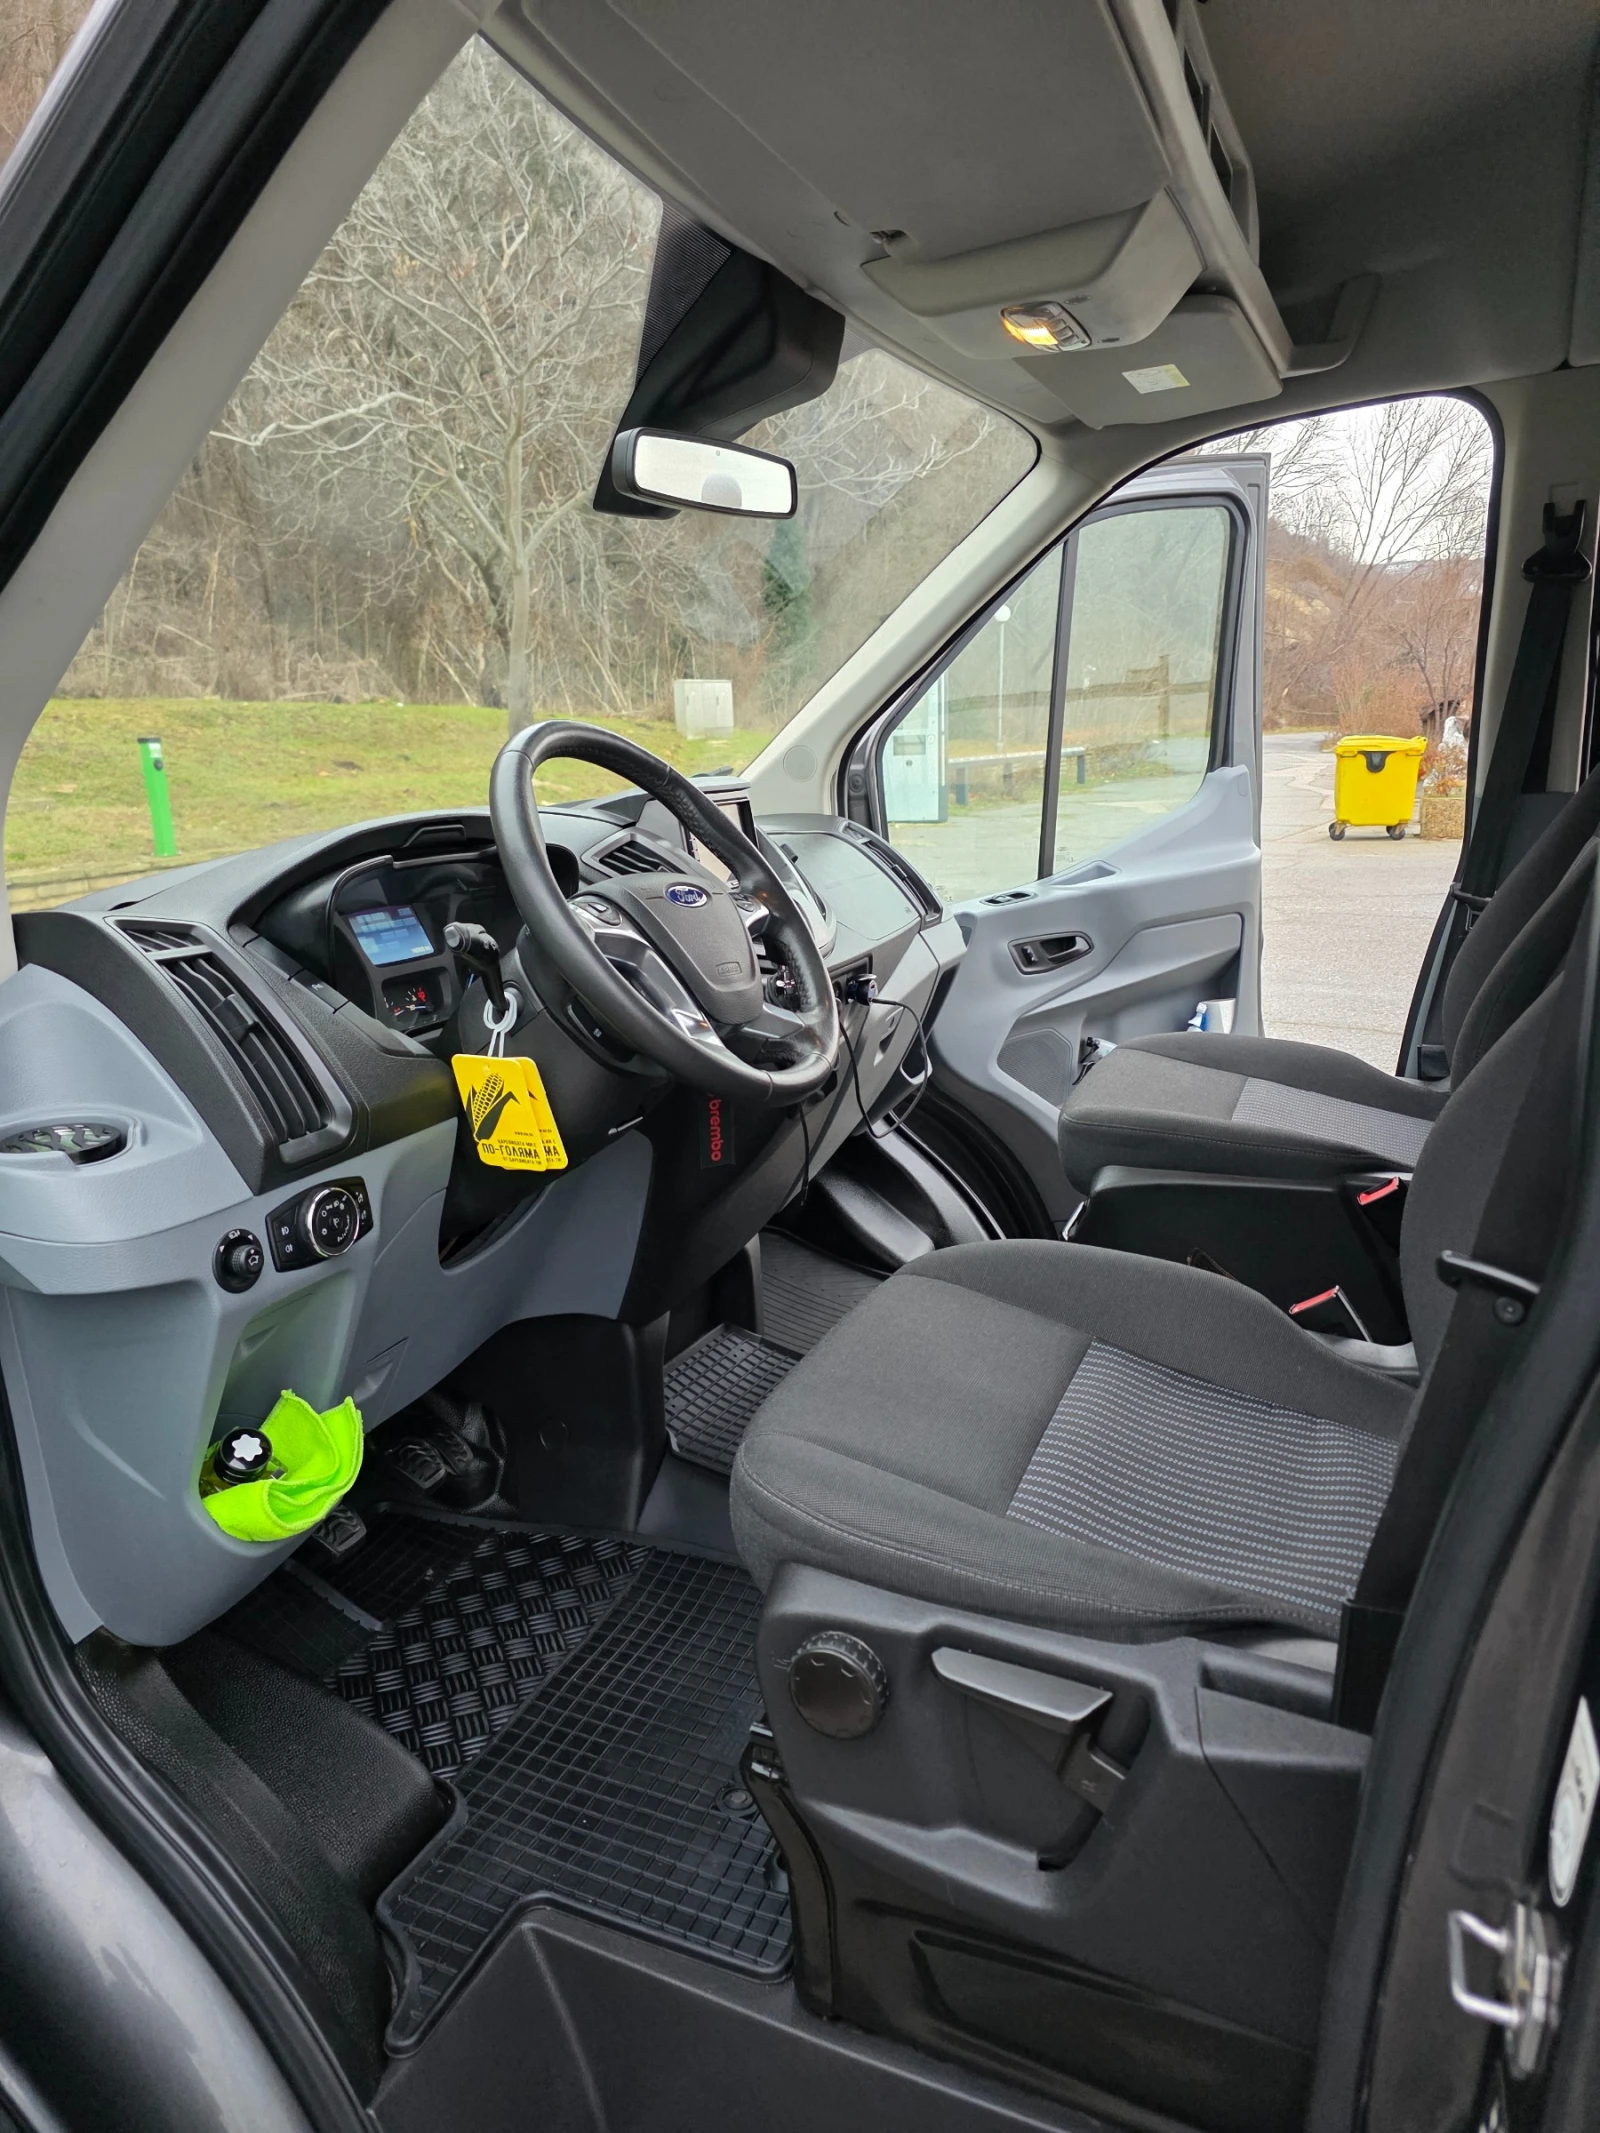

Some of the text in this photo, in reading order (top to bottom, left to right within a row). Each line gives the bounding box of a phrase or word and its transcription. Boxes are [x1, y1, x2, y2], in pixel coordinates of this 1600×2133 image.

[674, 888, 702, 902] Ford
[709, 1099, 724, 1161] brembo
[481, 1143, 540, 1159] ПО-ГОЛЯМА
